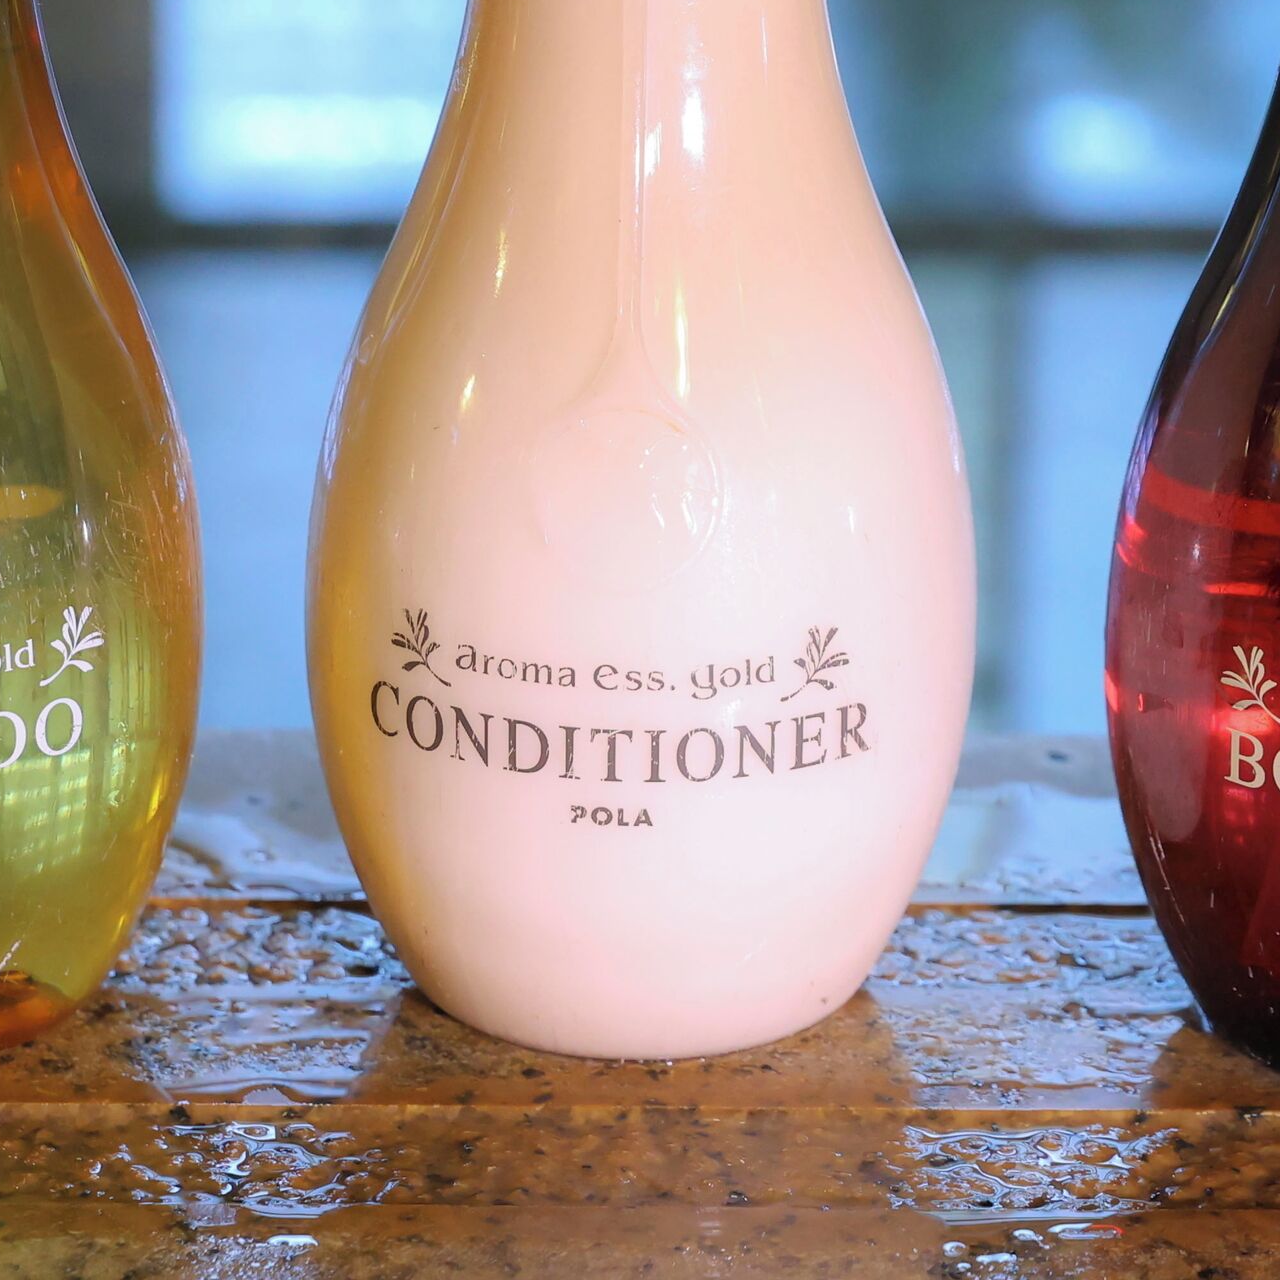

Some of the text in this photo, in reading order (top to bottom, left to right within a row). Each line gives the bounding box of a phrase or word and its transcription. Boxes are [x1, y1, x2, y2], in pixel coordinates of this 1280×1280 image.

[454, 644, 776, 700] aroma ess. gold
[370, 680, 872, 784] CONDITIONER
[570, 805, 654, 827] POLA
